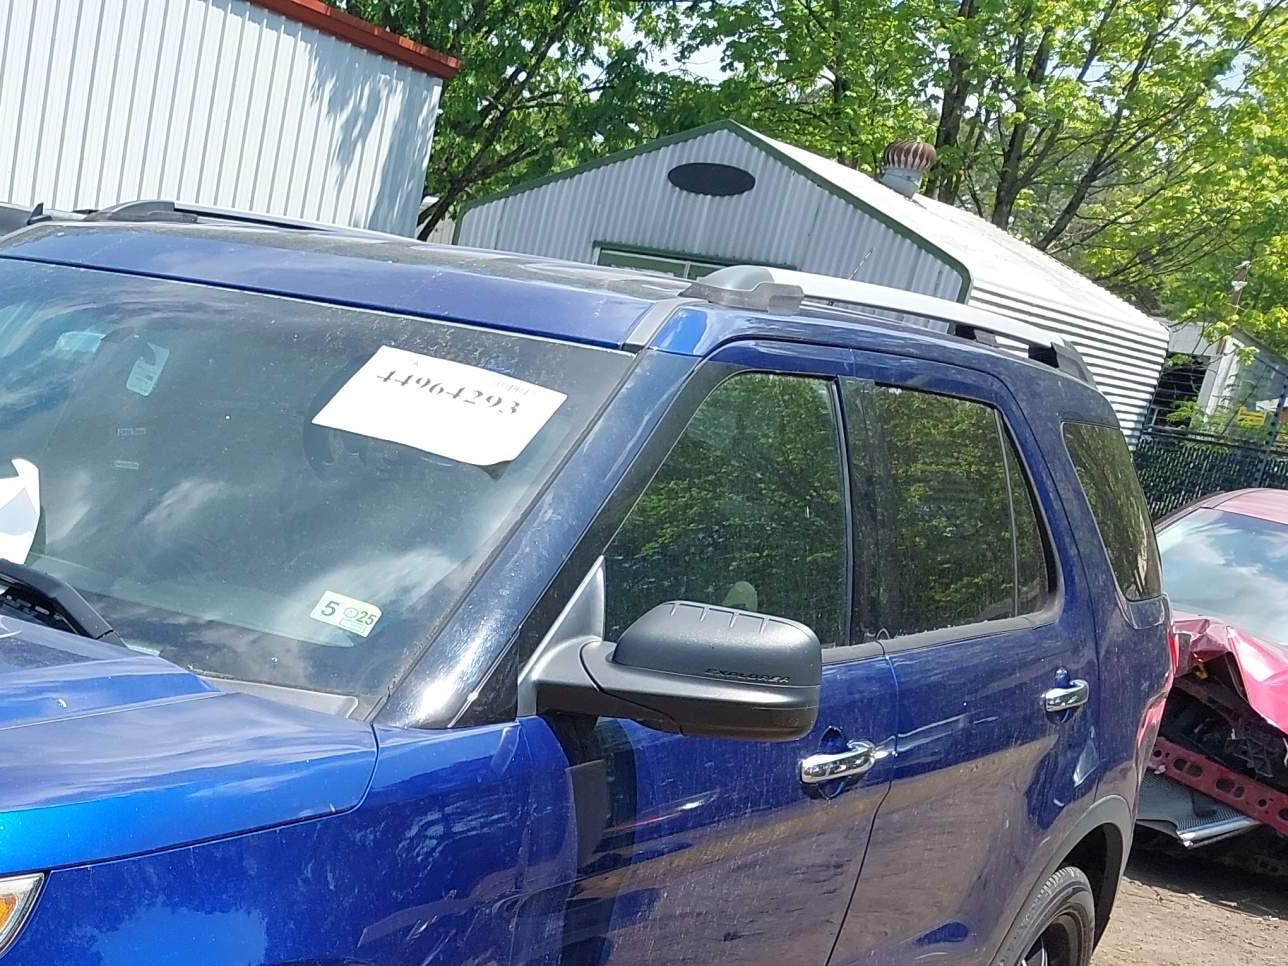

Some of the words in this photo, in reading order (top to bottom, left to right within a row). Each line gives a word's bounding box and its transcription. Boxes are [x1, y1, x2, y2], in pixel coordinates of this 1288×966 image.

[376, 368, 521, 415] 44964293
[320, 600, 341, 617] 5
[355, 610, 377, 626] 25
[704, 667, 792, 684] EXPLORER
